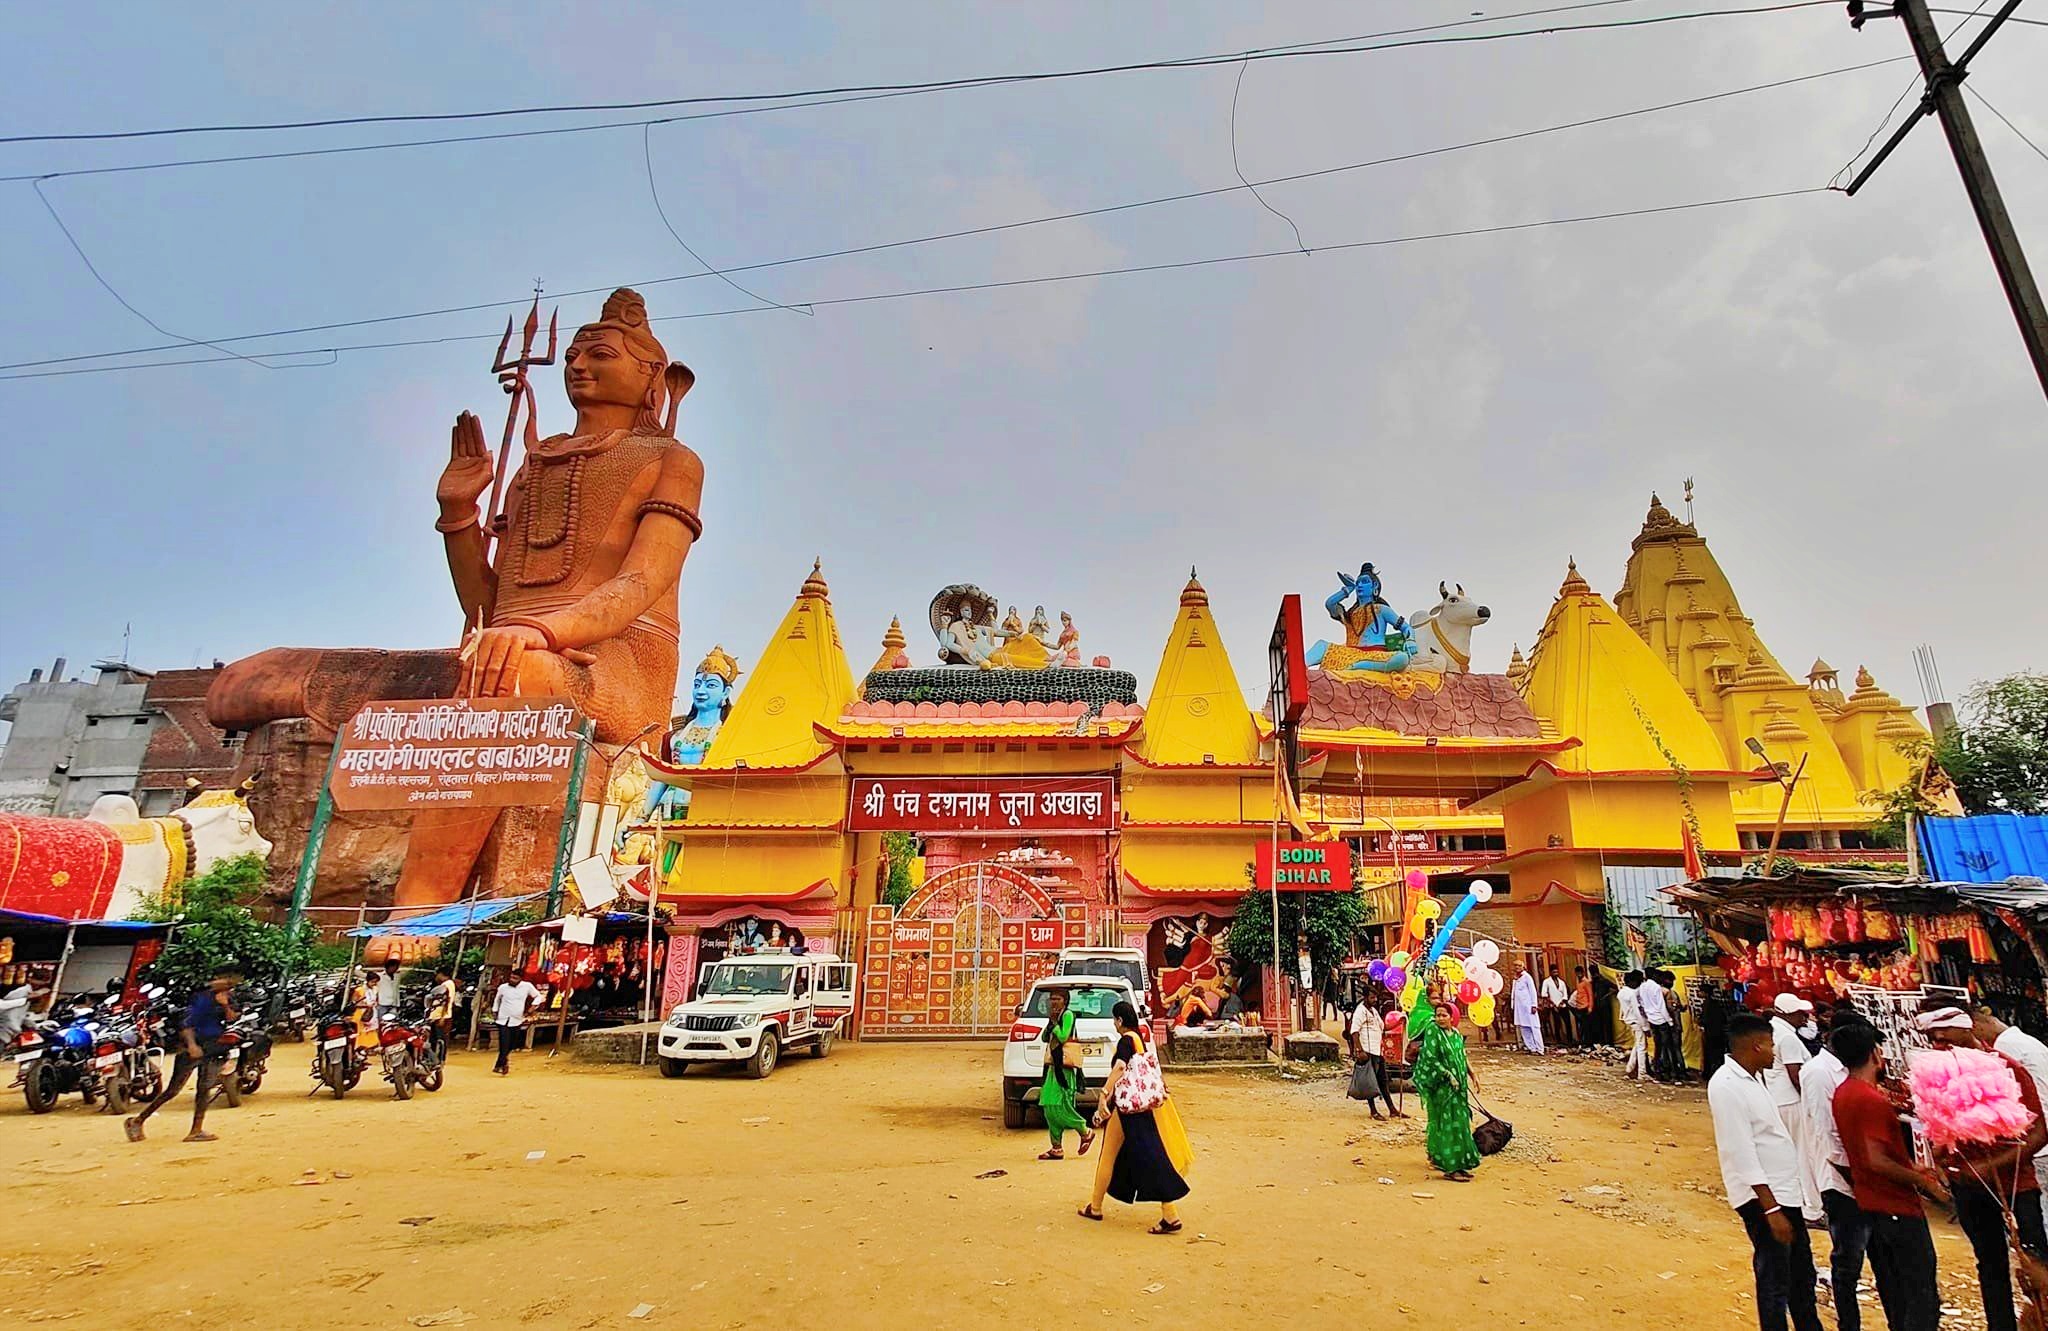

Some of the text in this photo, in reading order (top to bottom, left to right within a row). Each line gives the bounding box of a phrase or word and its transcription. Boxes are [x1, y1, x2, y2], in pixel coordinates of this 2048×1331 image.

[500, 704, 541, 740] महादेव
[541, 703, 575, 739] मंदिर
[863, 783, 1103, 826] श्री पंच दशनाम जूना अखाड़ा
[1280, 849, 1326, 863] BODH
[1277, 869, 1331, 883] BIHAR
[895, 924, 1054, 943] सोमनाथ धाम
